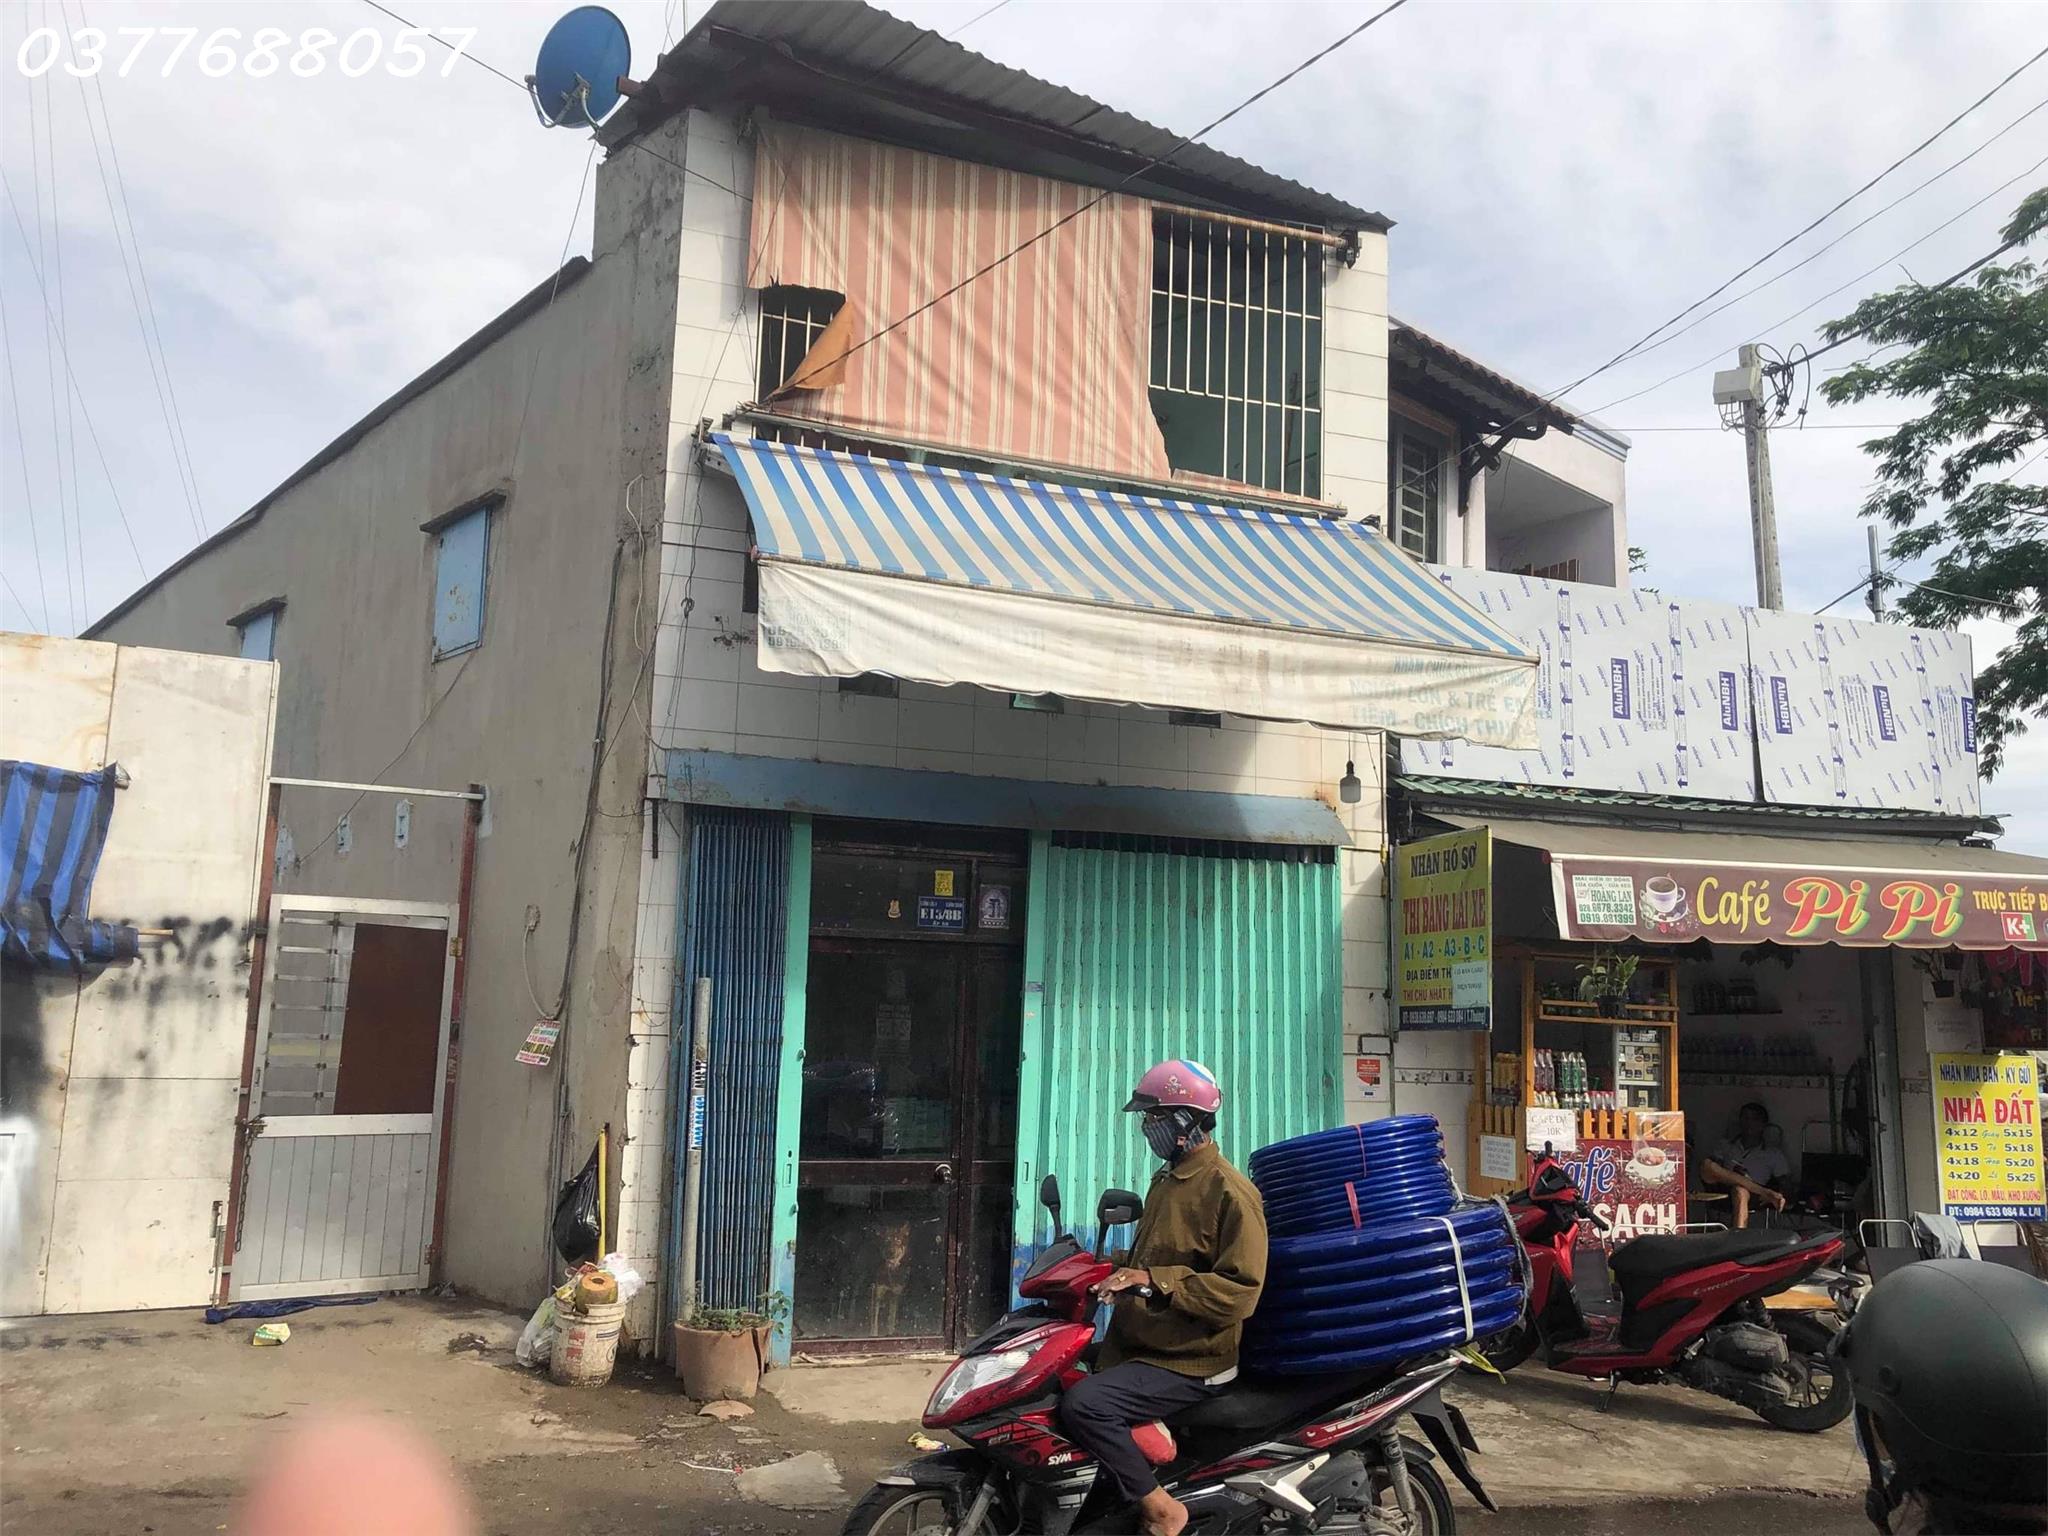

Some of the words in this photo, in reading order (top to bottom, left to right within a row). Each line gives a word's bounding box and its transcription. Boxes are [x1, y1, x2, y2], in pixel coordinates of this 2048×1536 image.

[1591, 887, 1616, 903] HOÀNG
[1618, 890, 1632, 902] LAN
[1697, 877, 1771, 934] Café
[1972, 888, 2007, 914] TRỰC
[2008, 886, 2036, 911] TIẾP
[1403, 898, 1419, 935] THI
[1471, 888, 1486, 929] XE
[1783, 877, 1870, 937] Pi
[1880, 880, 1964, 940] Pi
[1404, 942, 1414, 961] A1
[1422, 941, 1434, 959] A2
[1444, 938, 1456, 957] A3
[1463, 936, 1470, 955] B
[1478, 934, 1485, 954] C
[1940, 1061, 1961, 1085] NHẬN
[1963, 1065, 1980, 1082] MUA
[1983, 1062, 1998, 1083] BÁN
[2005, 1063, 2015, 1084] KÝ
[1943, 1090, 1987, 1123] NHÀ
[1994, 1089, 2034, 1124] ĐẤT
[1945, 1127, 1978, 1137] 4x12
[2004, 1128, 2033, 1137] 5x15
[1946, 1142, 1979, 1151] 4x15
[2005, 1143, 2034, 1152] 5x18
[1947, 1157, 1979, 1166] 4x18
[2005, 1158, 2035, 1167] 5x20
[1555, 1146, 1616, 1205] afé
[1948, 1171, 1980, 1180] 4x20
[2007, 1173, 2036, 1182] 5x25
[1963, 1206, 1984, 1217] 0984
[1985, 1206, 2001, 1217] 633
[1048, 1452, 1072, 1466] SYM
